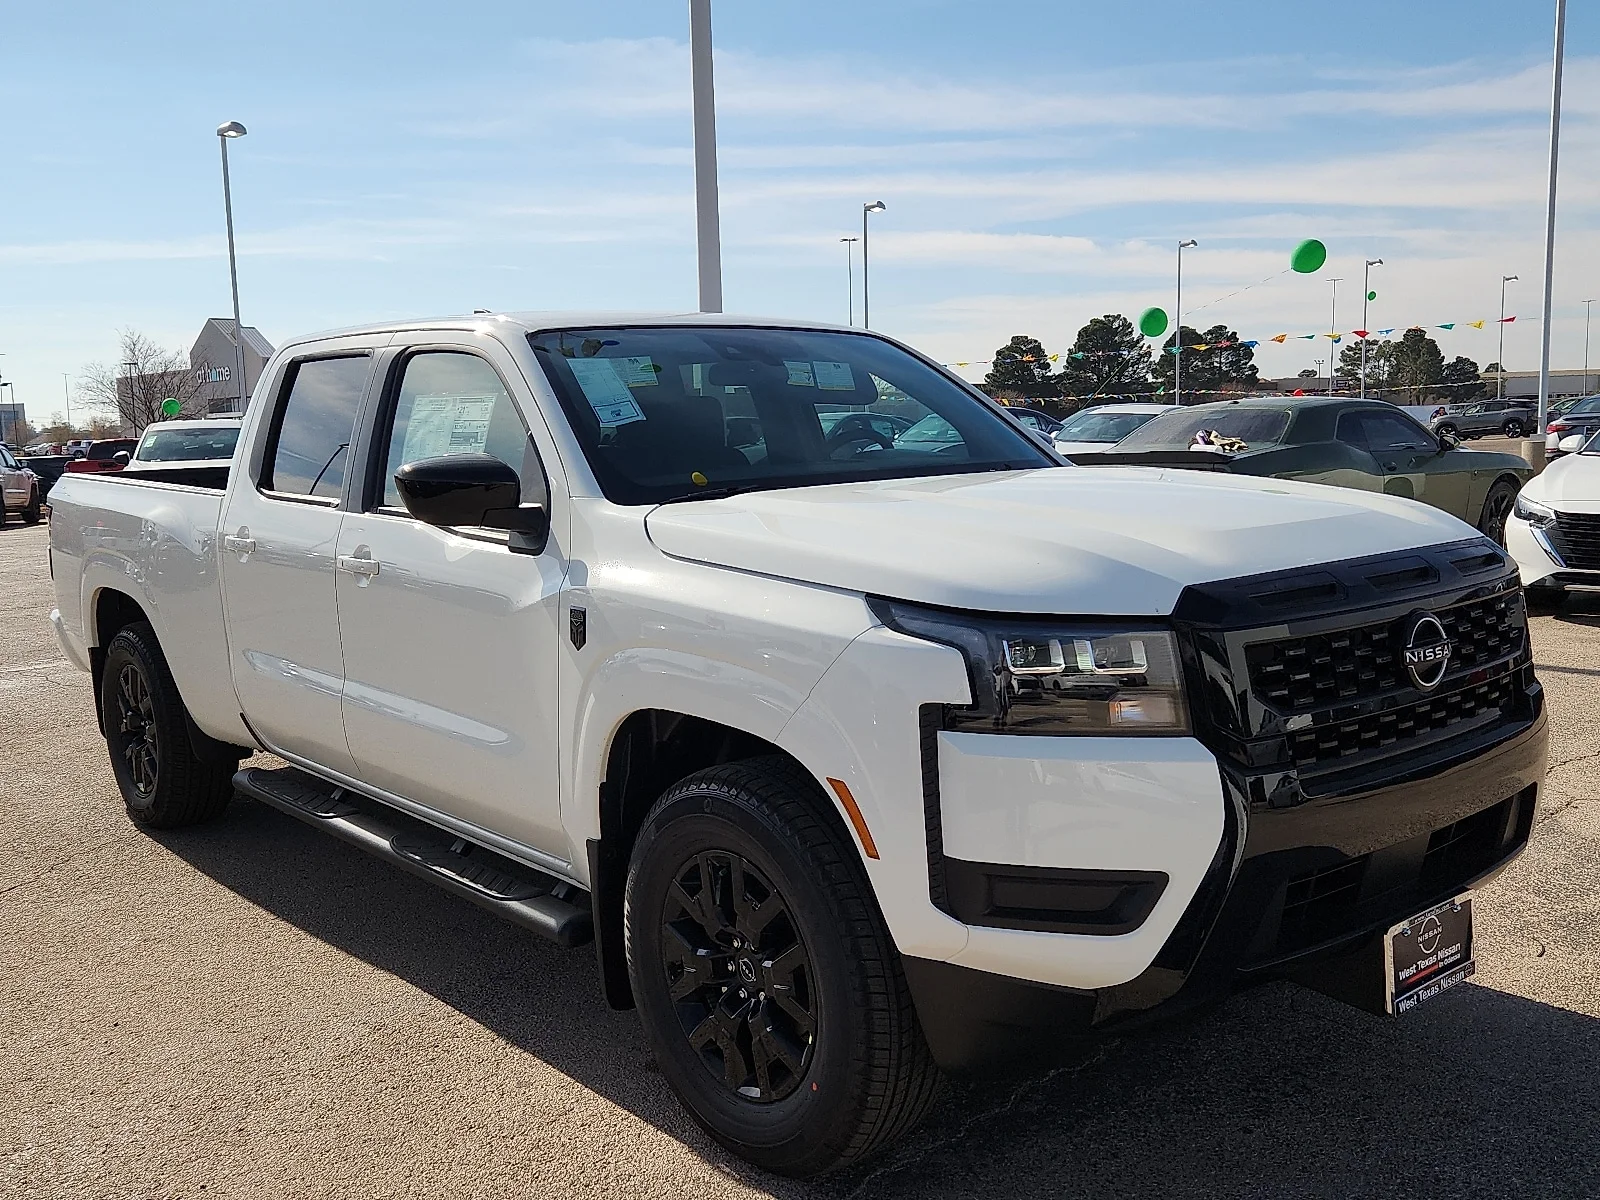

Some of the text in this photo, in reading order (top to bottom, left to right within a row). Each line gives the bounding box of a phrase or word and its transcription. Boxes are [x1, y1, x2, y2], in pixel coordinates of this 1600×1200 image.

[1417, 925, 1442, 944] NISSAN
[1399, 943, 1461, 980] West Texas Nissan
[1399, 971, 1465, 1013] West Texas Nissan
